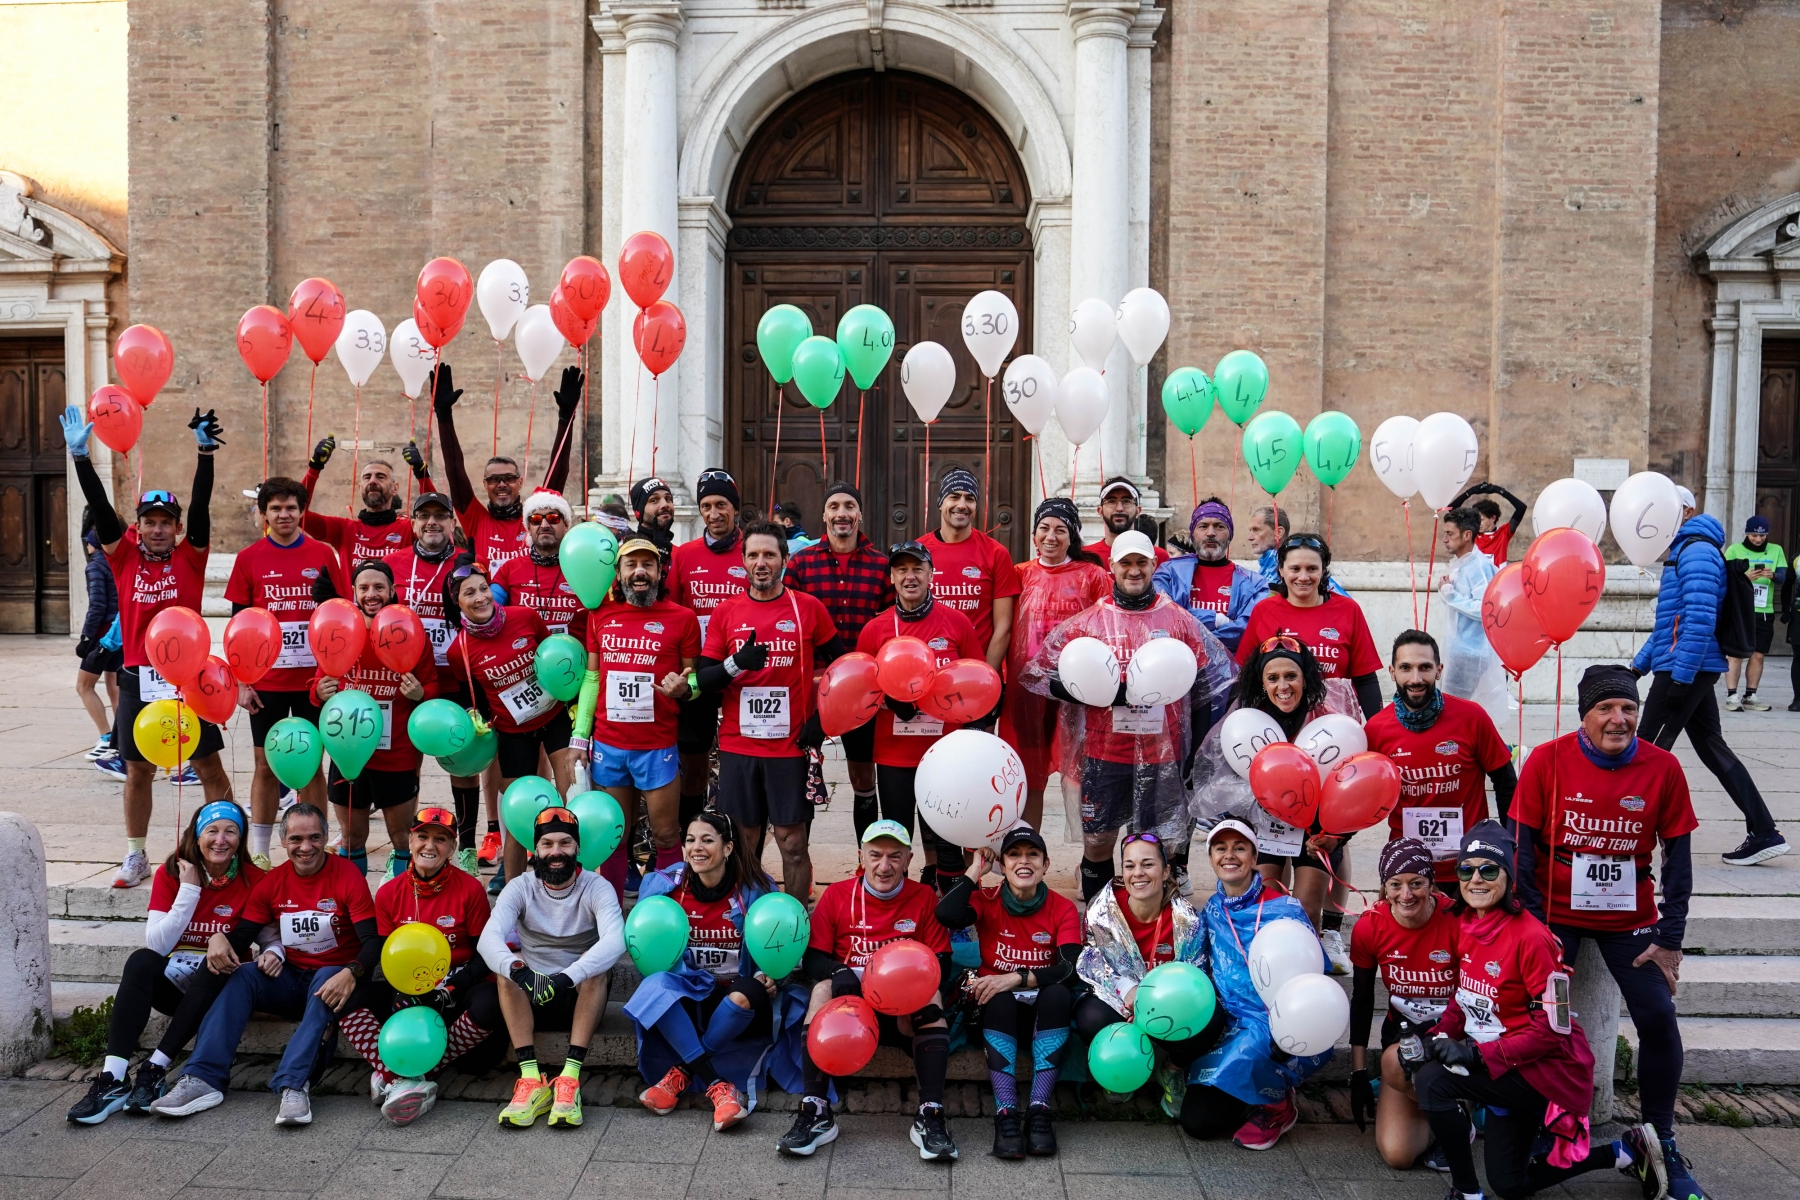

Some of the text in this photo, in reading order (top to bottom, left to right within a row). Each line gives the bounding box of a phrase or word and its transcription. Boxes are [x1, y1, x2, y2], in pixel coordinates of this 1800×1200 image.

[965, 312, 1008, 337] 3.30
[263, 584, 312, 601] Riunit
[690, 580, 745, 597] Riunite
[267, 600, 318, 612] PACING TEAM
[519, 592, 576, 611] Riunite
[957, 600, 979, 611] TEAM
[551, 611, 574, 623] TEAM
[282, 631, 305, 645] 521
[601, 633, 661, 652] Riunite
[483, 650, 535, 681] Riunite
[603, 652, 657, 666] PACING TEAM
[771, 656, 794, 668] TEAM
[493, 670, 521, 689] PACING
[374, 685, 398, 698] TEAM
[512, 682, 544, 711] F155
[618, 682, 640, 698] 511
[747, 698, 781, 714] 1022
[267, 729, 311, 755] 3.15
[1435, 778, 1460, 795] TEAM
[1418, 819, 1448, 837] 621
[1563, 809, 1643, 834] Riunite
[1563, 832, 1638, 851] PACING TEAM
[1586, 863, 1622, 882] 405
[292, 917, 320, 933] 546
[696, 949, 728, 964] F157
[995, 940, 1051, 963] Riunite
[1388, 963, 1454, 985] Riunite
[1460, 967, 1499, 998] Riunite
[1390, 983, 1426, 995] PACING
